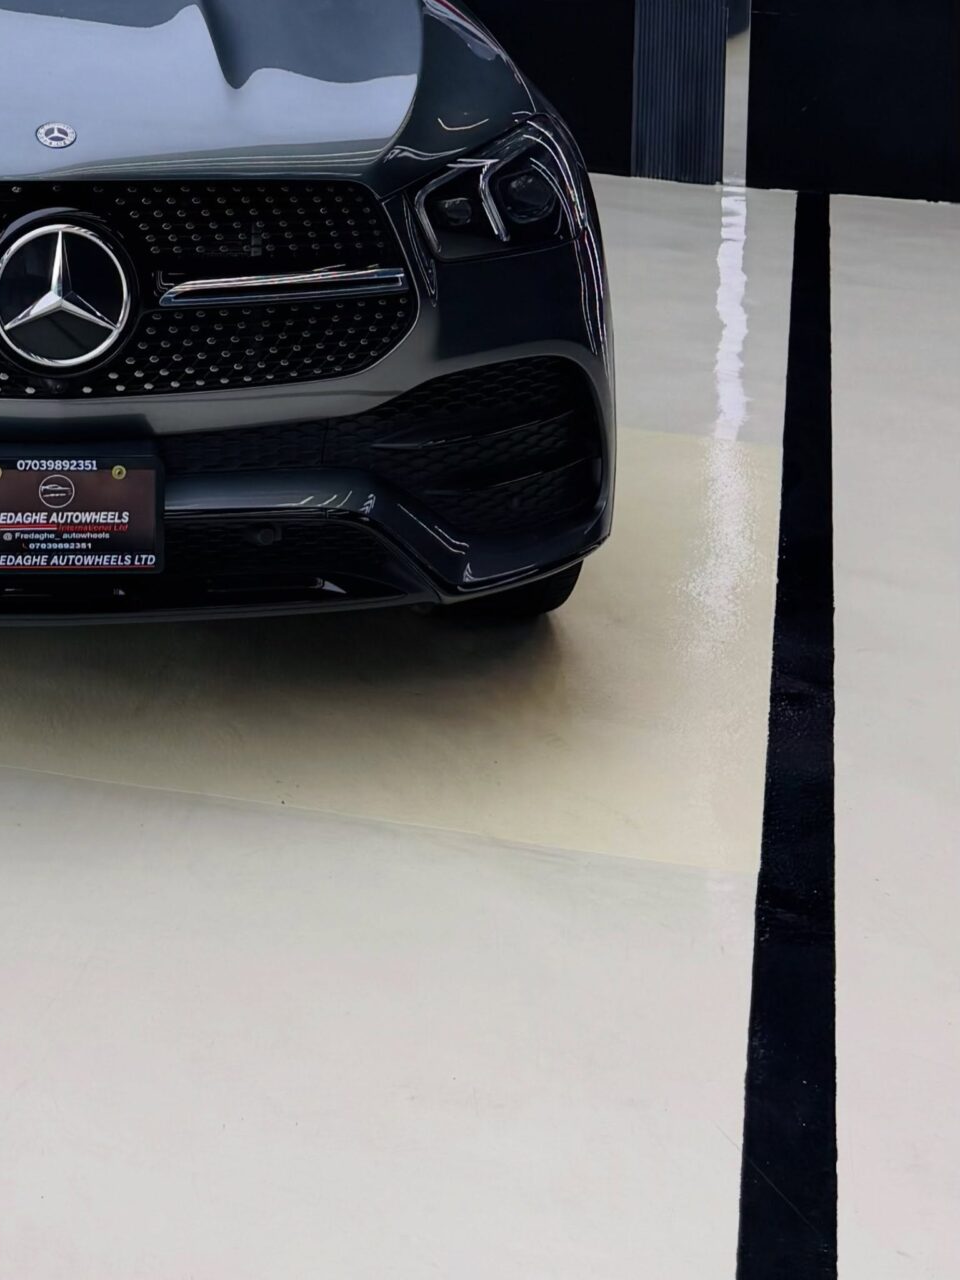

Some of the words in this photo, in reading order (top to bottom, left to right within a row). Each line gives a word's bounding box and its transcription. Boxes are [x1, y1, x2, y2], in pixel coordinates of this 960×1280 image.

[16, 459, 98, 471] 07039892351
[49, 511, 130, 524] AUTOWHEELS
[50, 554, 131, 566] AUTOWHEELS
[134, 554, 156, 566] LTD
